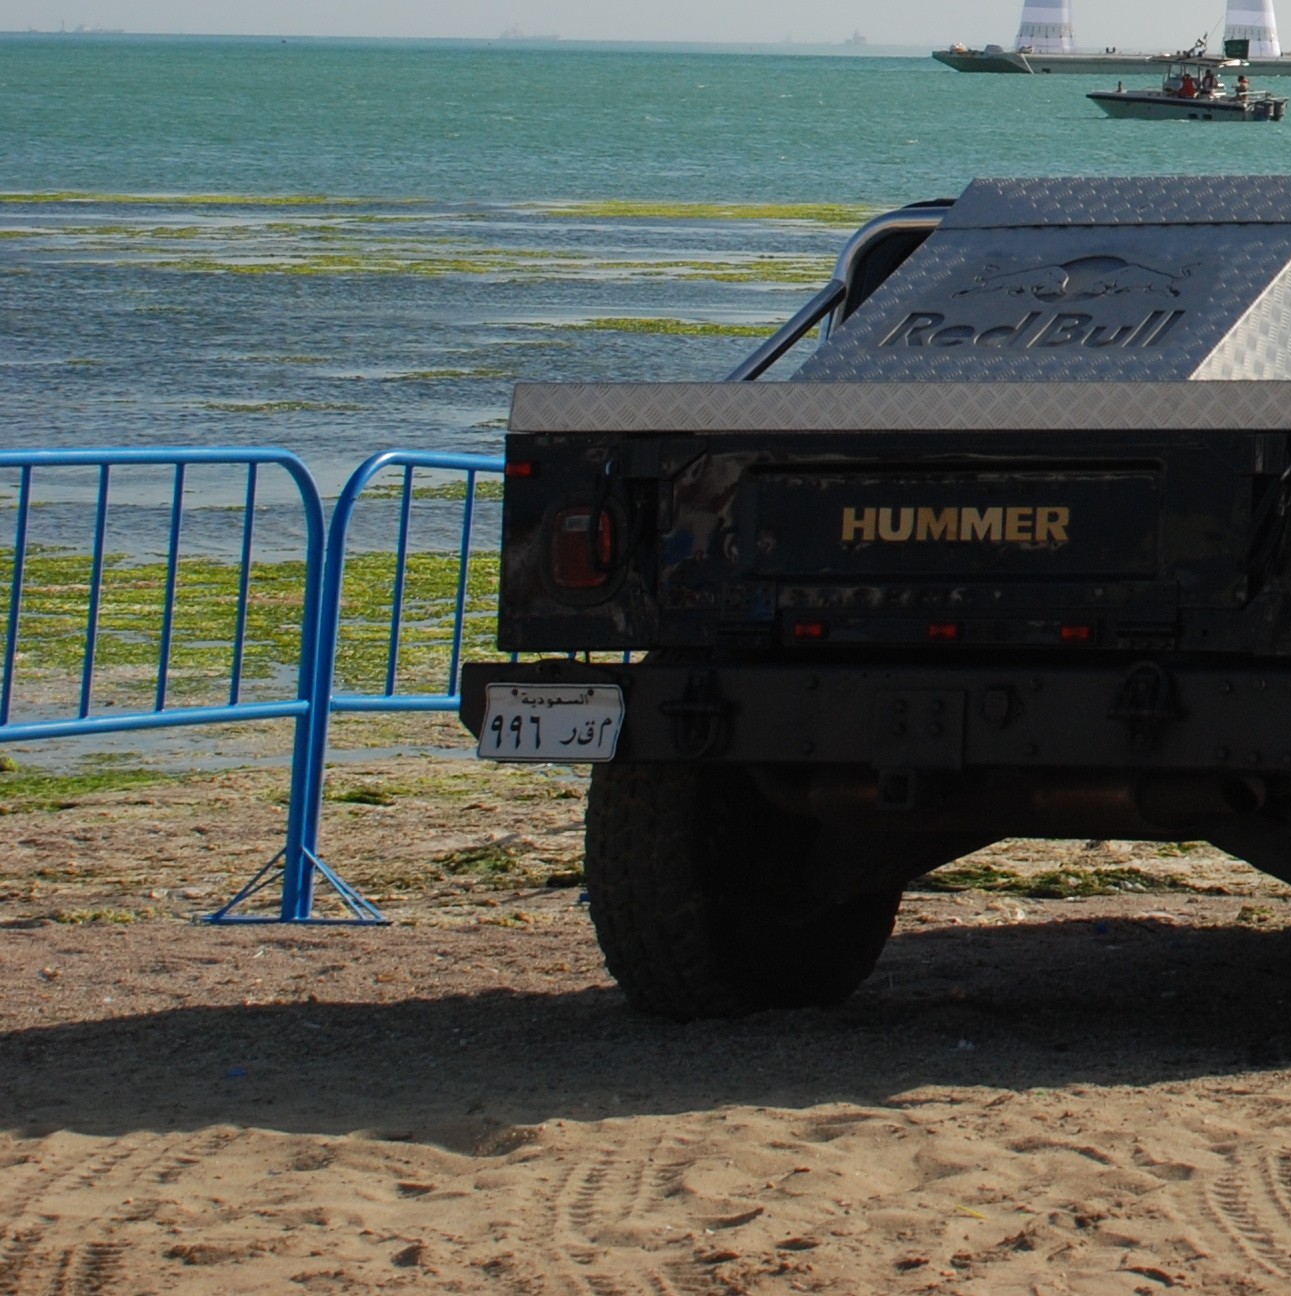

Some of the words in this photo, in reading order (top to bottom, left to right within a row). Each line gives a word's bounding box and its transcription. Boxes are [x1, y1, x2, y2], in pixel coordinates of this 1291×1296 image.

[878, 311, 1043, 348] Red
[1027, 310, 1186, 348] Bull
[841, 507, 1070, 542] HUMMER
